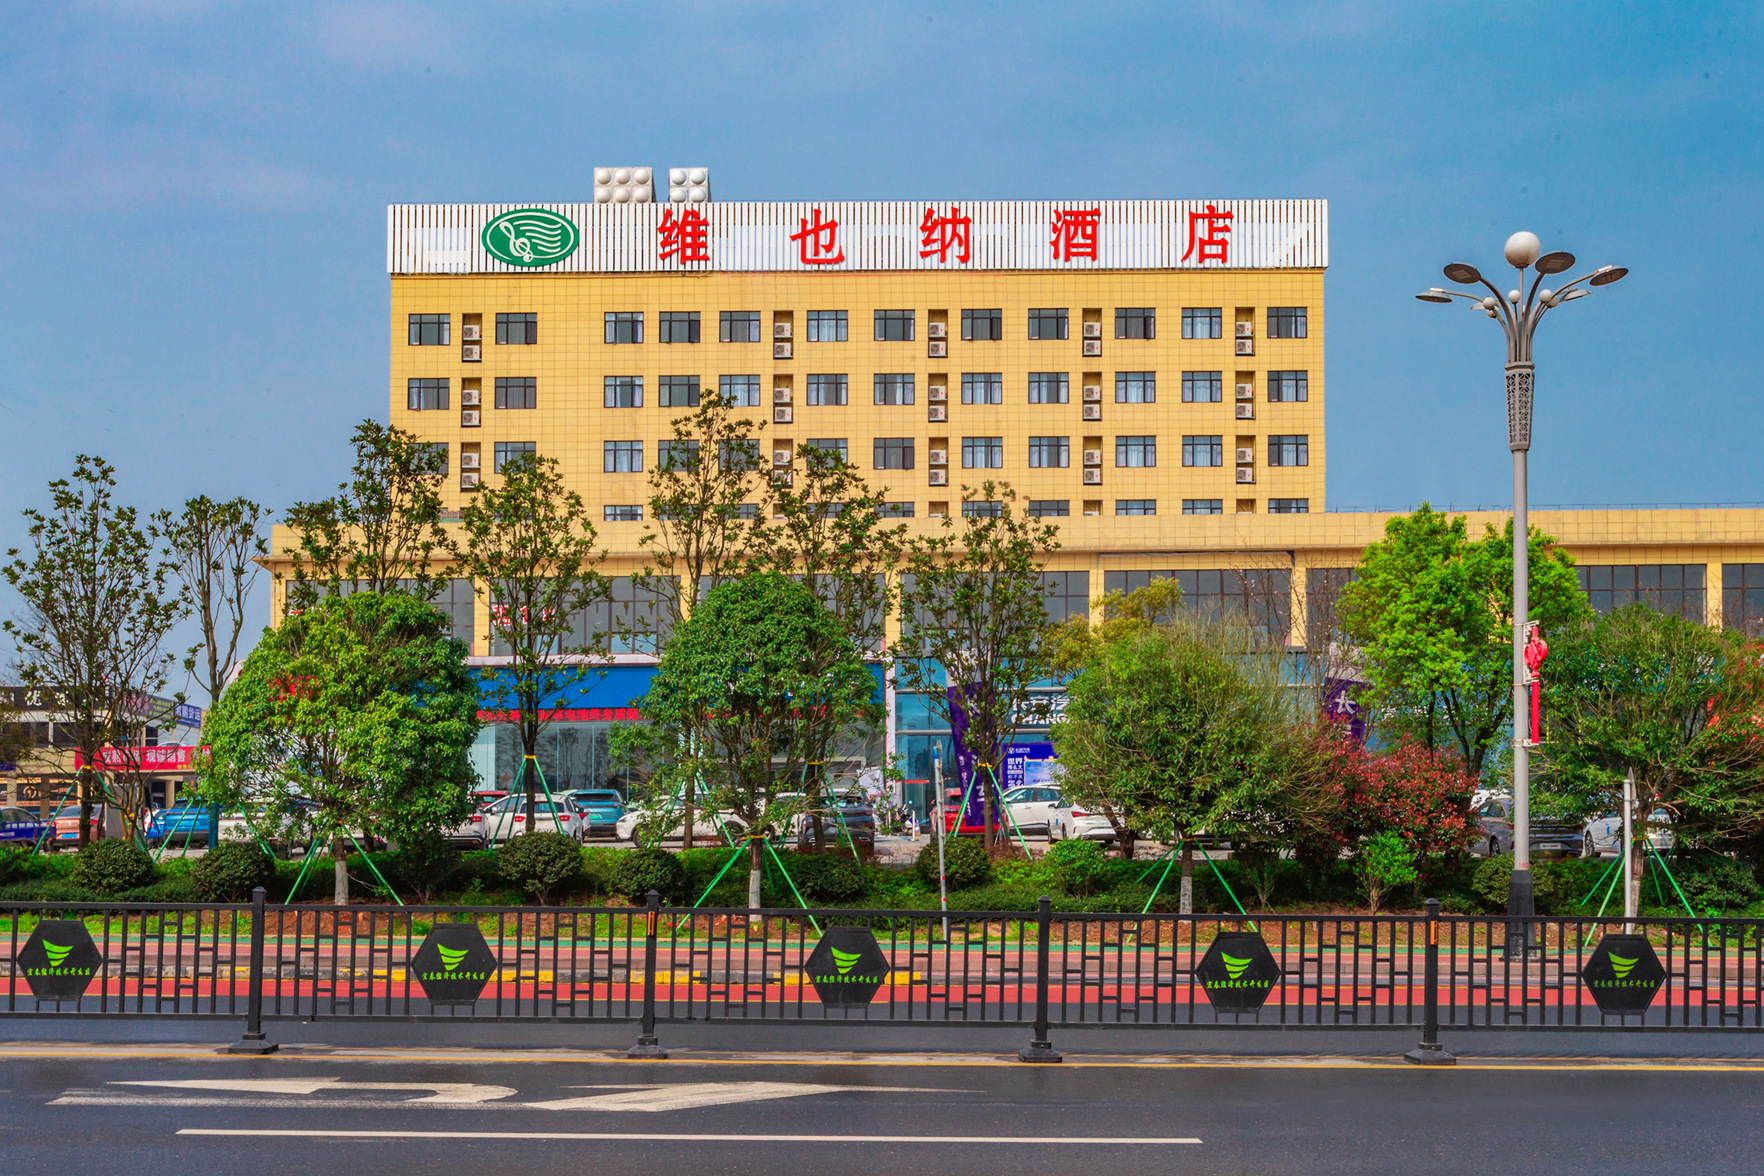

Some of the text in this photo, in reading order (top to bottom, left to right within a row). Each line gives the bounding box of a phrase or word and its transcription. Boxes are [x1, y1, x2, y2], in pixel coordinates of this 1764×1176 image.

[657, 205, 1234, 264] 维也纳酒店
